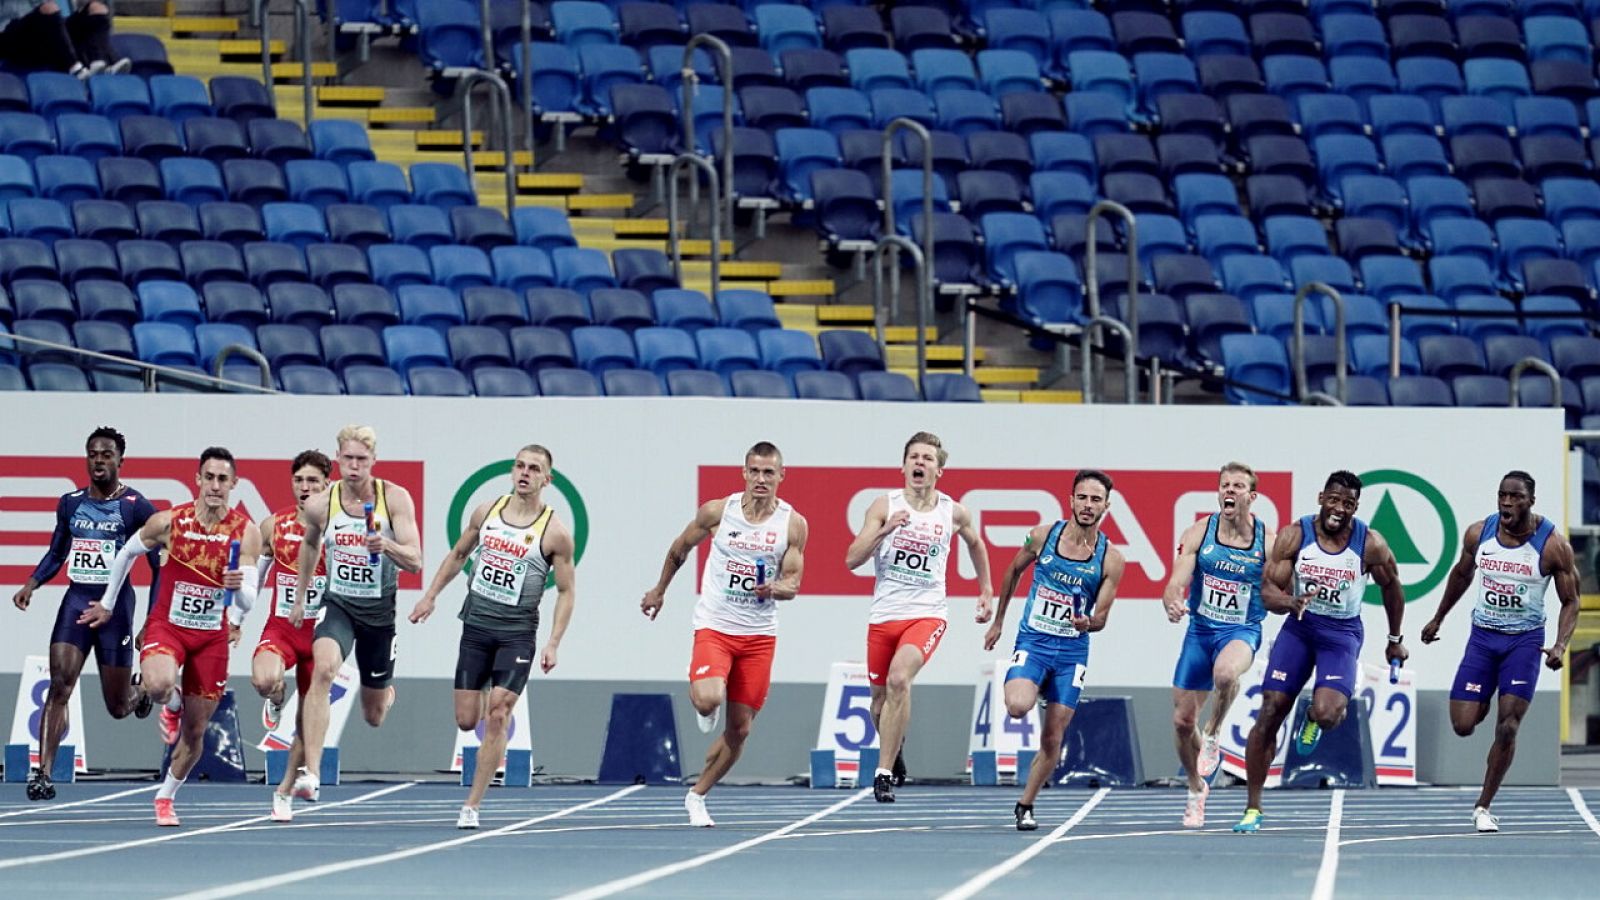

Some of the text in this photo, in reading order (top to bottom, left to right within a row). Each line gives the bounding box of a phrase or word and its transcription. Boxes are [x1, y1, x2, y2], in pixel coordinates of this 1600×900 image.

[74, 519, 120, 531] FRANCE
[72, 541, 101, 551] SPAR
[335, 533, 367, 546] GERM
[483, 535, 529, 559] GERMANY
[729, 540, 774, 552] POLSKA
[893, 538, 928, 554] SPAR
[73, 552, 107, 569] FRA
[334, 551, 368, 566] SPAR
[481, 552, 513, 571] SPAR
[893, 549, 932, 572] POL
[1214, 560, 1246, 573] ITALIA
[1480, 558, 1532, 576] GREAT BRITAIN
[336, 564, 375, 583] GER
[481, 565, 516, 590] GER
[1053, 571, 1082, 586] ITALIA
[1299, 563, 1356, 581] GREAT BRITAIN
[176, 584, 212, 598] SPAR
[729, 574, 756, 591] PO
[1204, 575, 1238, 593] SPAR
[1483, 576, 1515, 595] SPAR
[285, 588, 317, 604] EP
[1038, 586, 1073, 606] SPAR
[1208, 590, 1239, 609] ITA
[1485, 590, 1524, 608] GBR
[181, 596, 214, 615] ESP
[1042, 601, 1073, 621] ITA
[28, 679, 70, 741] 8
[834, 685, 876, 751] 5
[975, 681, 992, 747] 4
[1232, 685, 1263, 748] 3
[1380, 692, 1411, 758] 2
